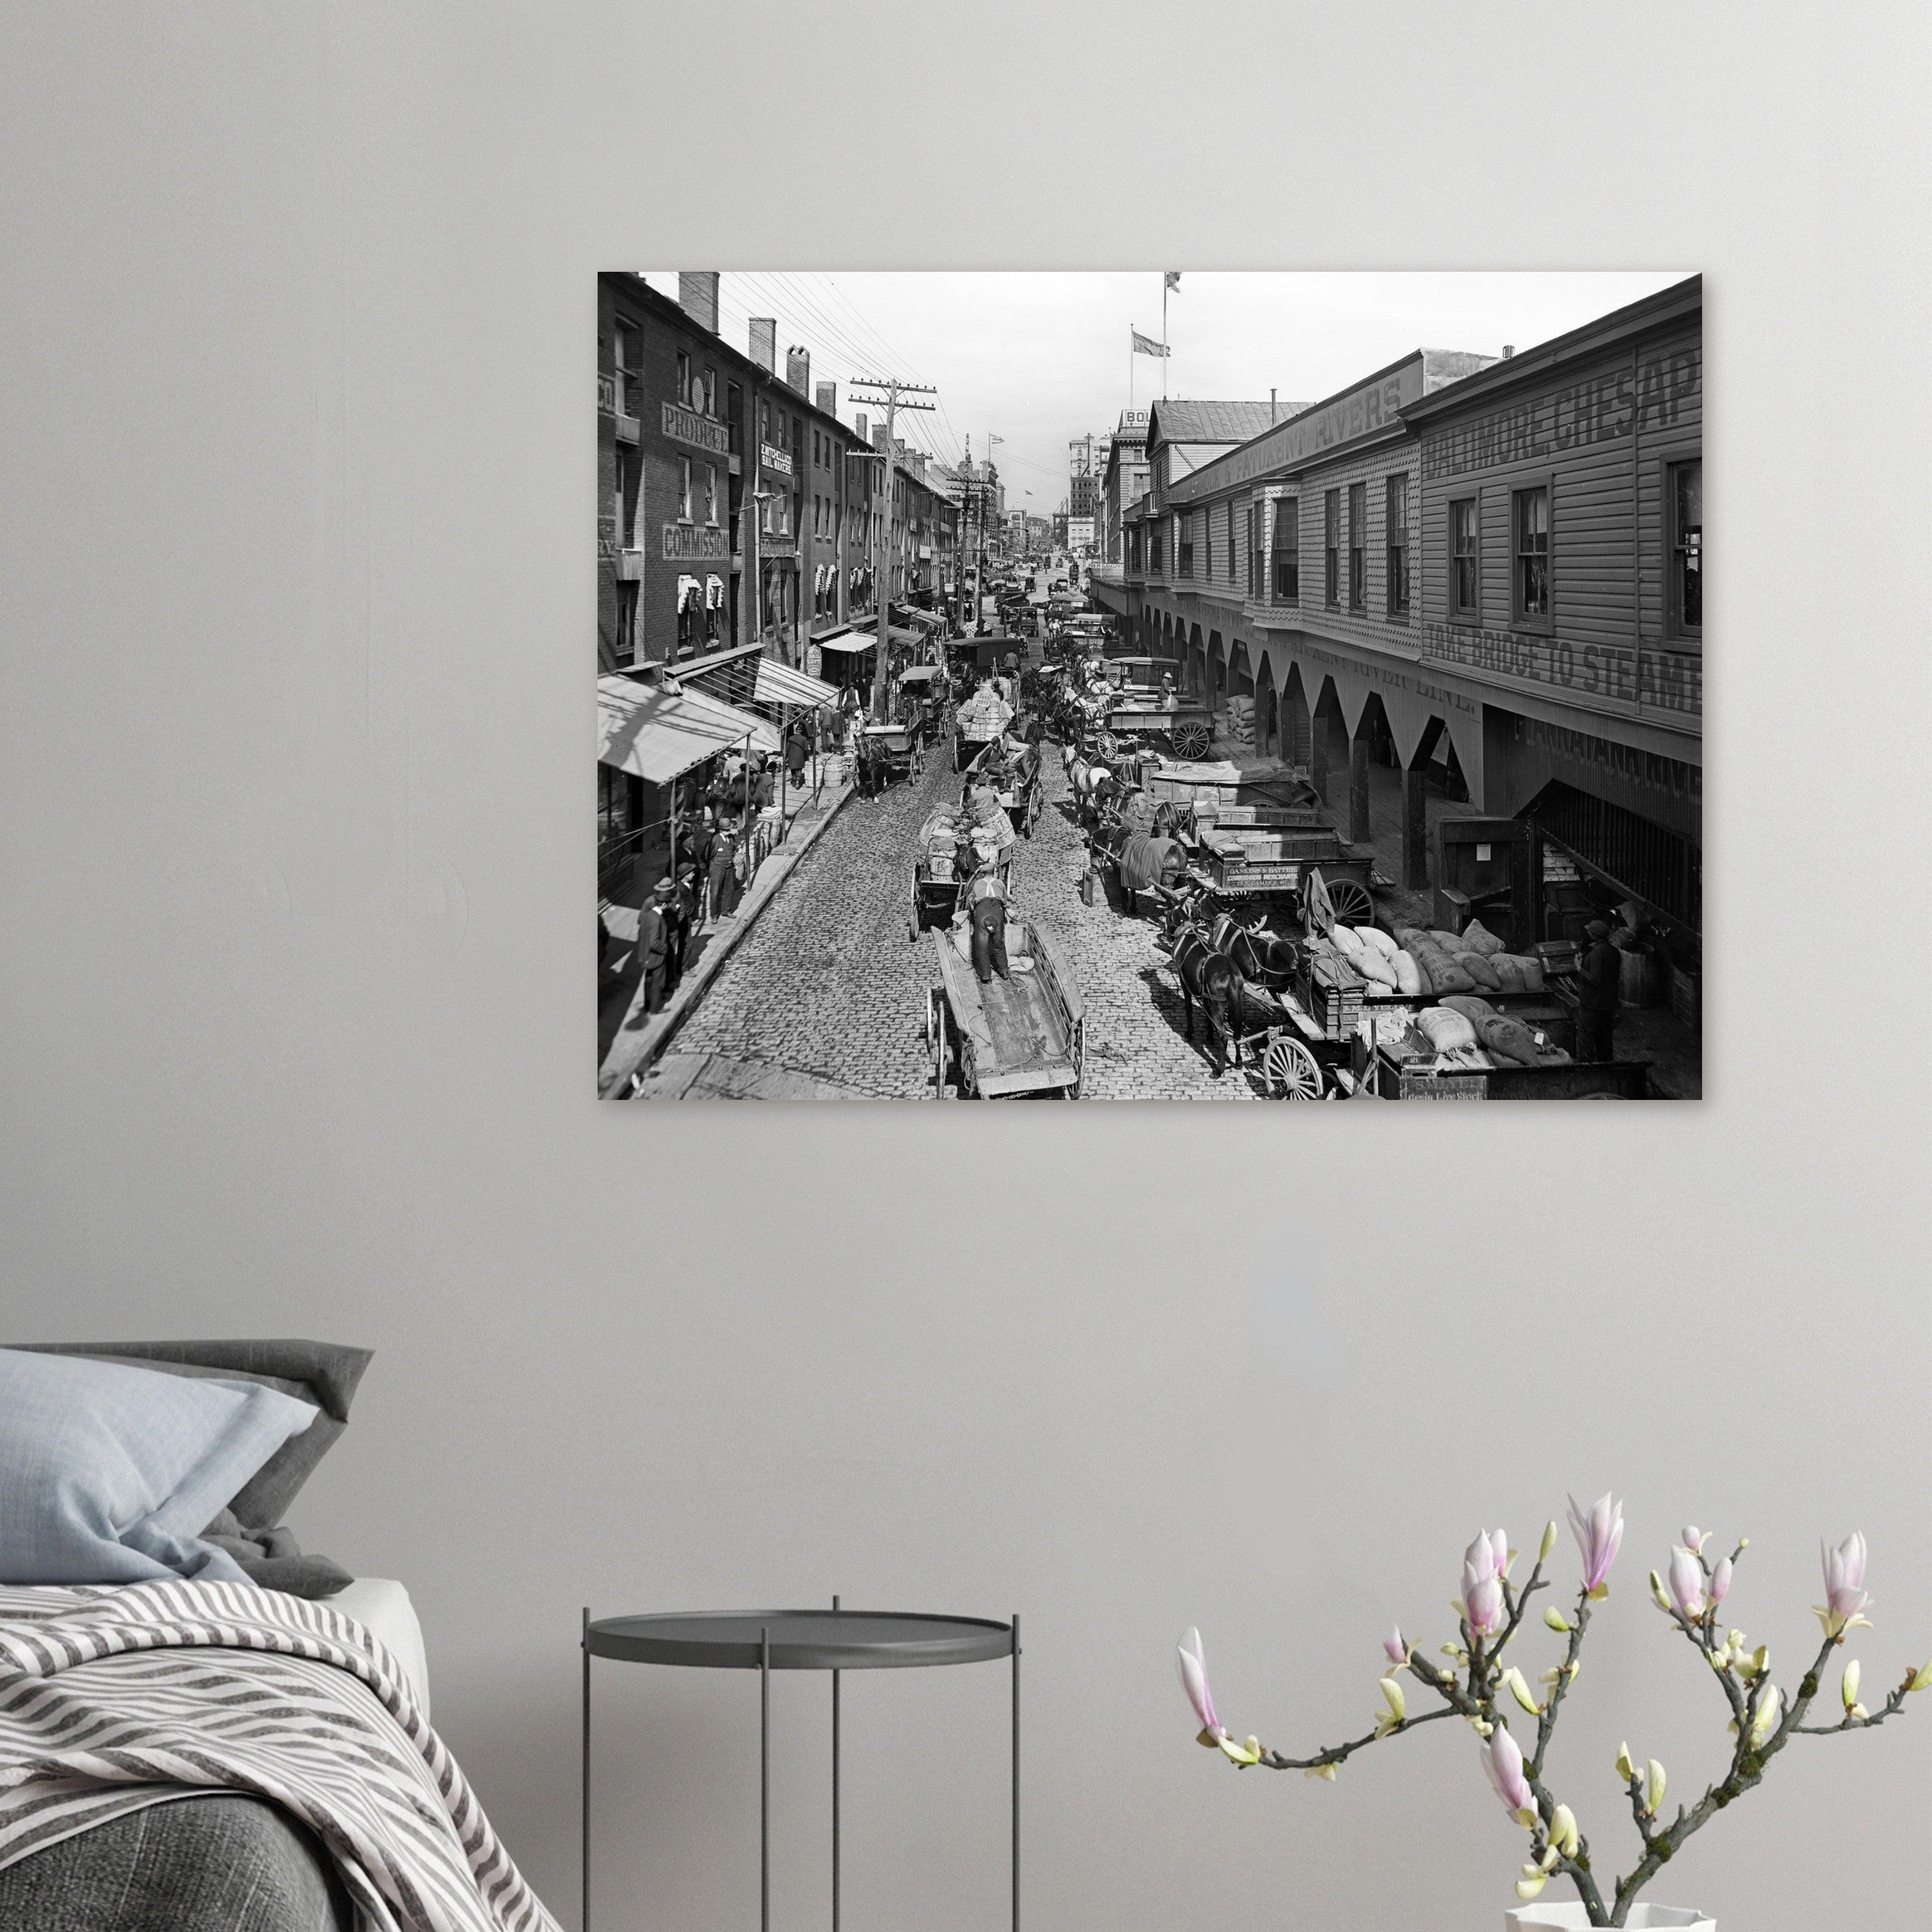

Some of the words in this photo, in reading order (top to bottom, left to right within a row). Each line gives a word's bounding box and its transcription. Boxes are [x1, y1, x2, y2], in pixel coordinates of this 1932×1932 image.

[1315, 377, 1400, 449] RIVERS
[665, 528, 728, 557] COMMISSION
[1427, 623, 1466, 663] TAKE
[1472, 629, 1540, 681] BRIDGE
[1546, 638, 1574, 687] TO
